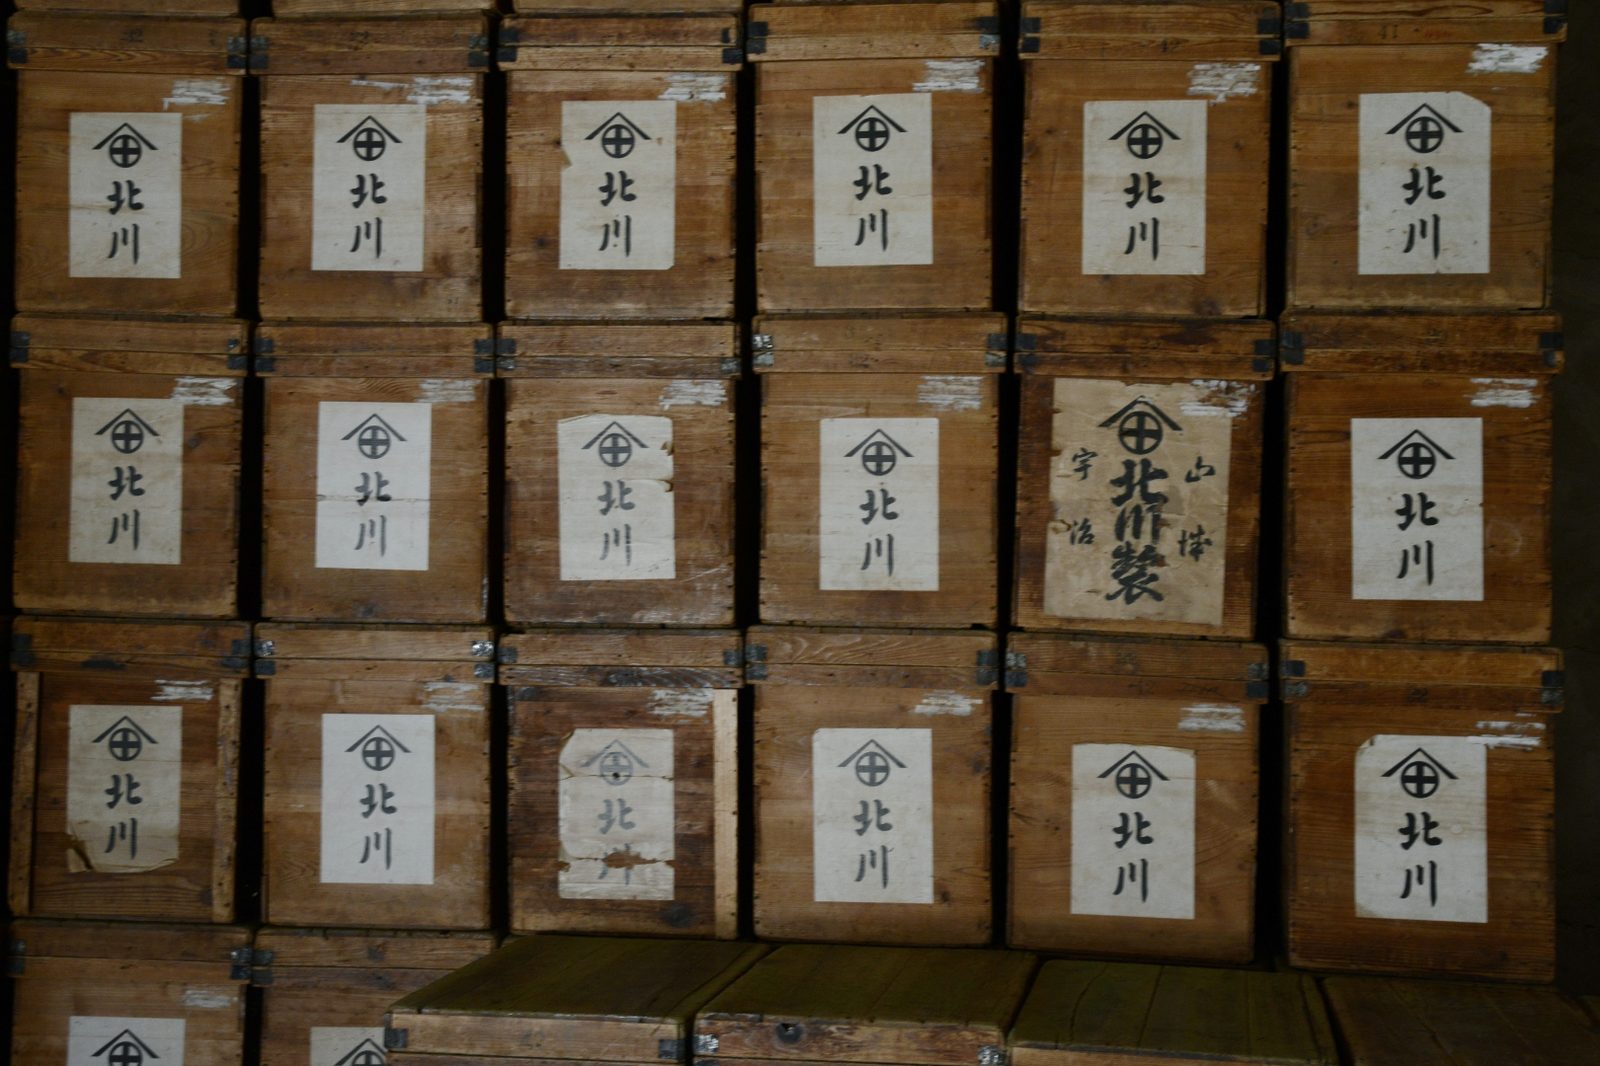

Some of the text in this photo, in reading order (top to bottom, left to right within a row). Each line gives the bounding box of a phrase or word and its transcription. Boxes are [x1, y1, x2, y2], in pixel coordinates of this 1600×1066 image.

[106, 179, 145, 265] 北川
[349, 172, 388, 259] 北川
[598, 170, 638, 257] 北川
[852, 163, 893, 251] 北川
[1122, 170, 1166, 261] 北川
[1401, 163, 1447, 260] 北川
[107, 465, 146, 551] 北川
[354, 471, 393, 555] 北川
[597, 479, 635, 566] 北川
[859, 487, 899, 577] 北川
[1394, 491, 1440, 587] 北川
[104, 772, 144, 860] 北川
[359, 782, 398, 870] 北川
[853, 799, 893, 889] 北川
[1112, 811, 1155, 903] 北川
[1397, 810, 1443, 908] 北川
